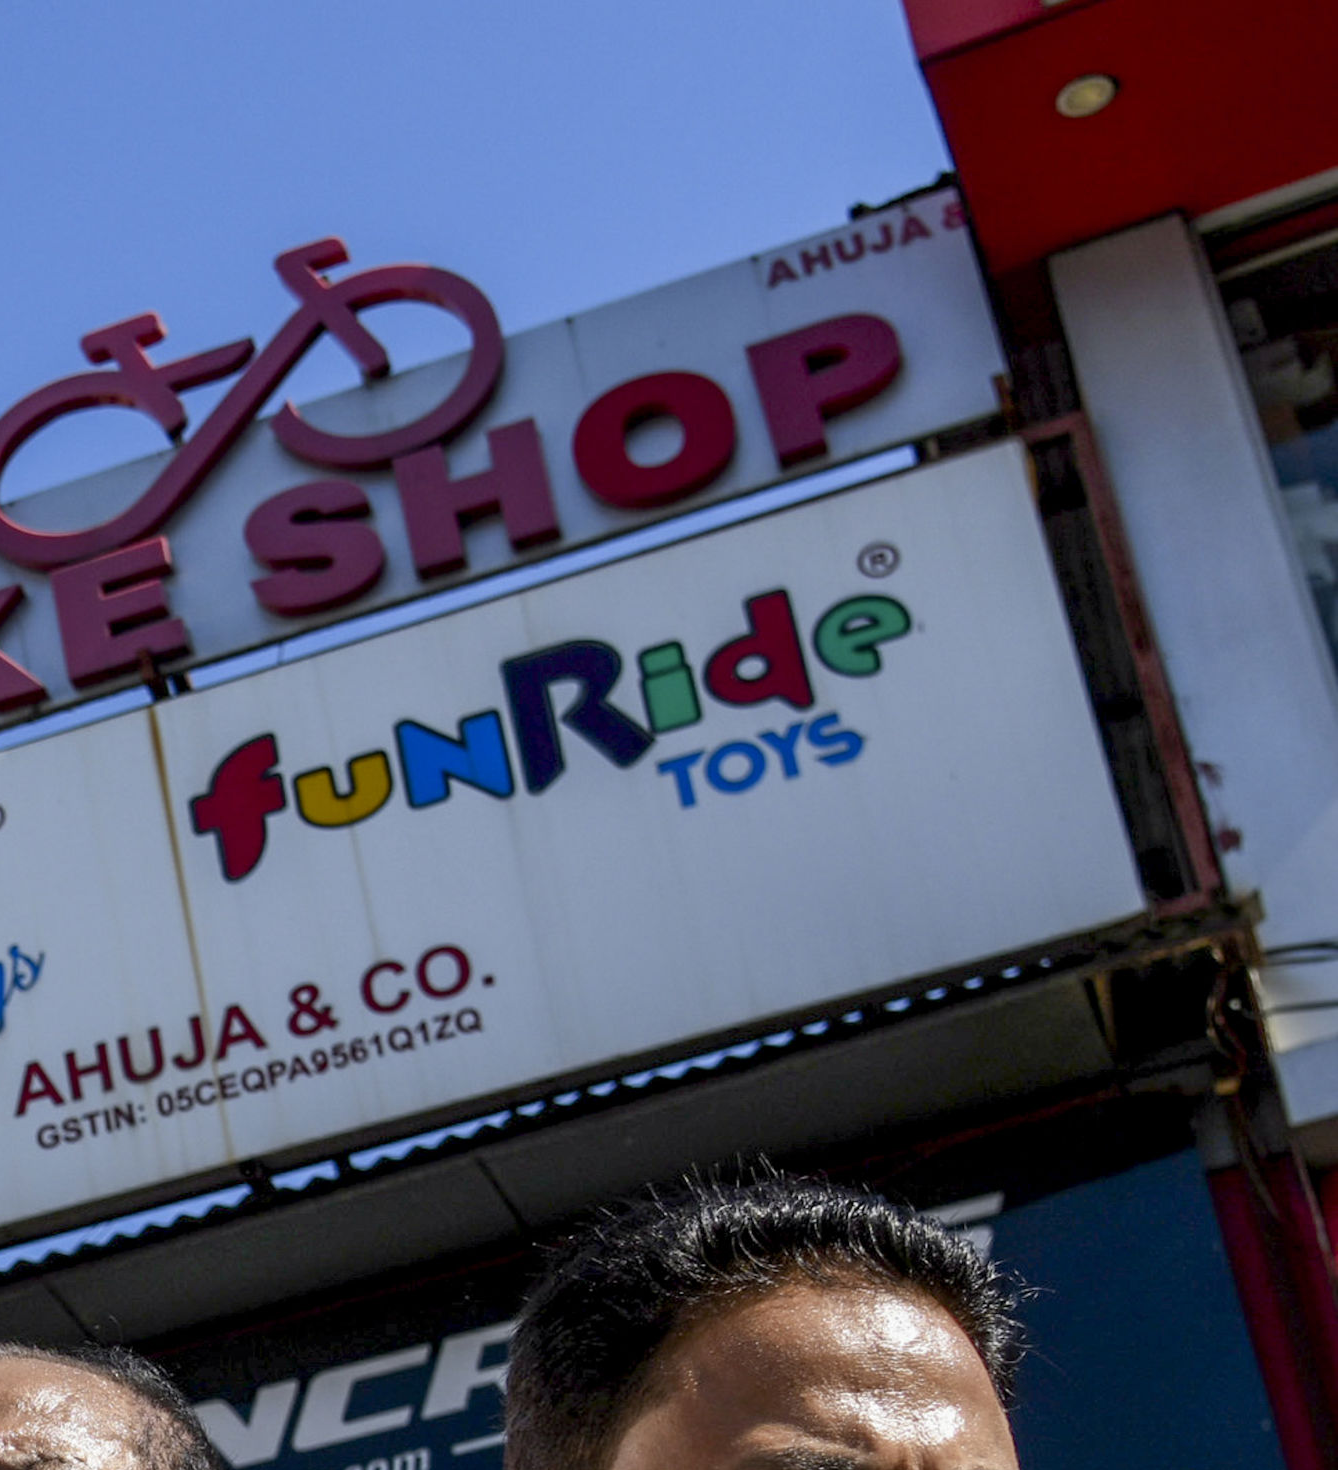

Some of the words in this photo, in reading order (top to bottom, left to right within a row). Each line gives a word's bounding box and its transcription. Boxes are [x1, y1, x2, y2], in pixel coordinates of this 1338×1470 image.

[767, 214, 931, 290] AHUJA
[244, 312, 904, 618] SHOP
[658, 713, 866, 809] TOYS
[15, 1003, 268, 1117] AHUJA
[287, 982, 339, 1037] &
[360, 943, 496, 1015] CO.
[35, 1101, 148, 1150] GSTIN:
